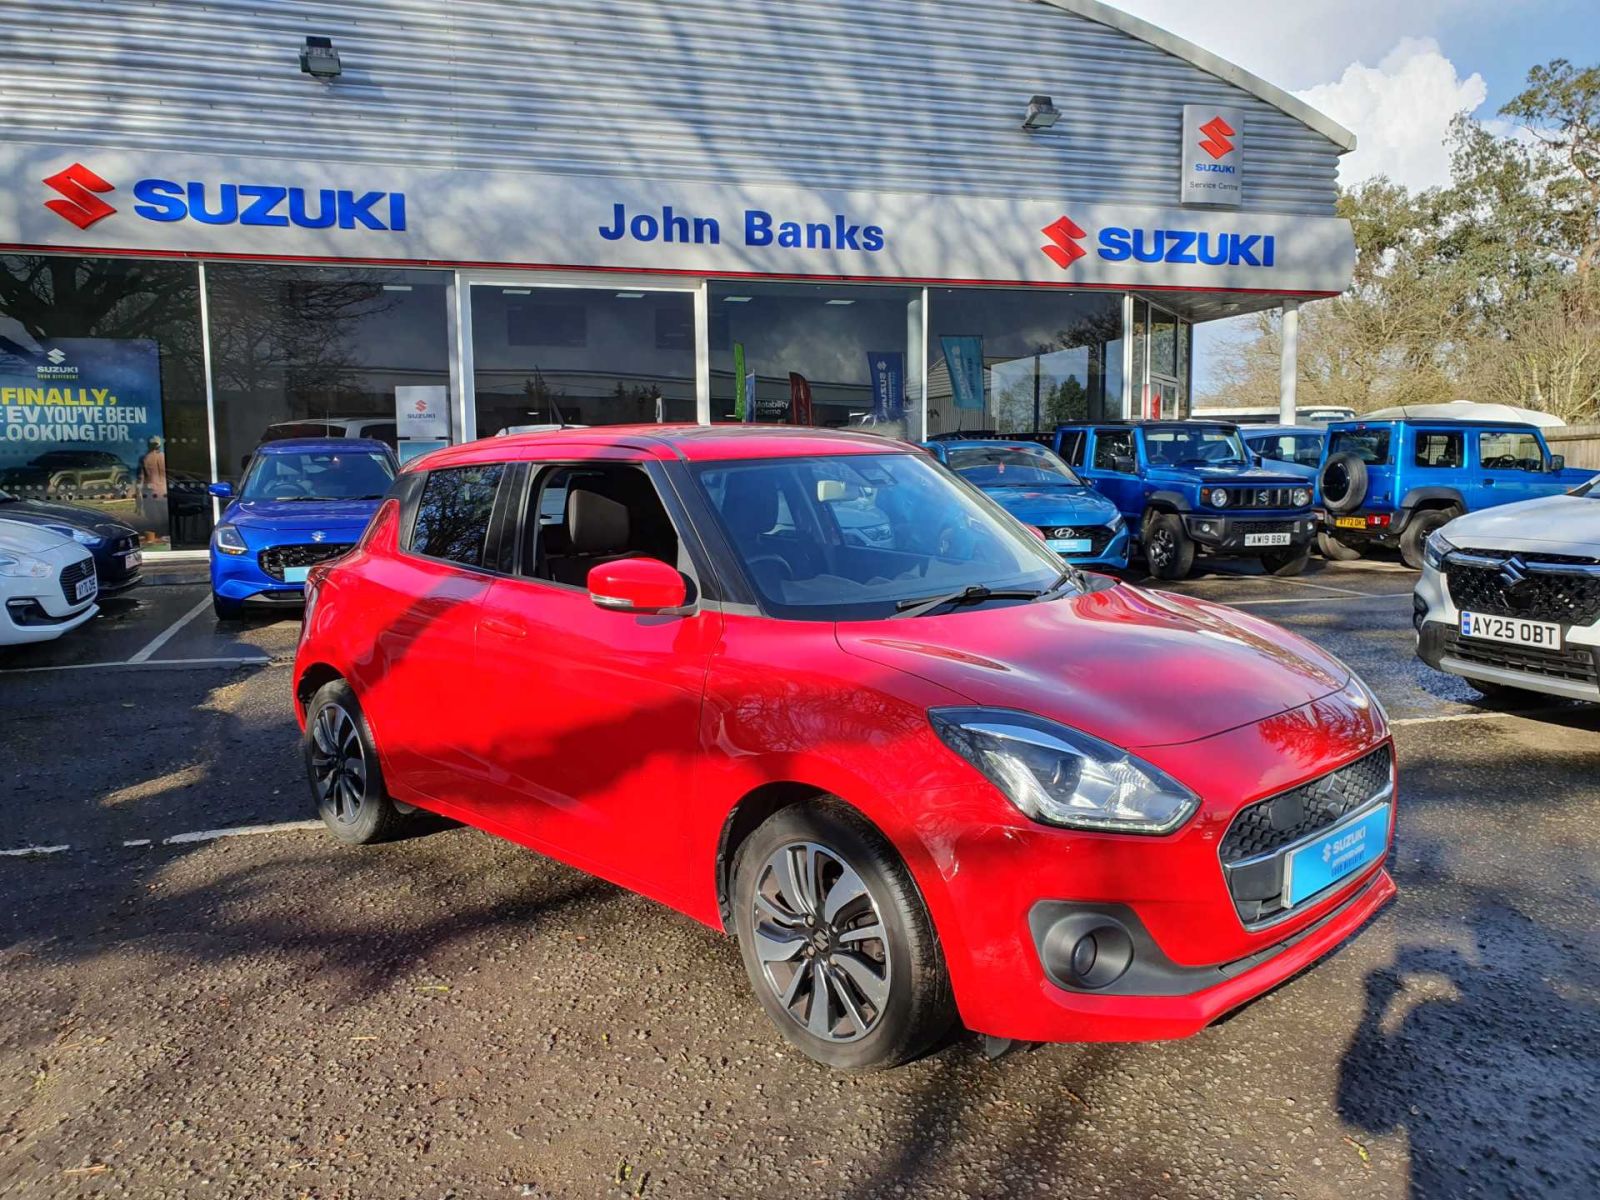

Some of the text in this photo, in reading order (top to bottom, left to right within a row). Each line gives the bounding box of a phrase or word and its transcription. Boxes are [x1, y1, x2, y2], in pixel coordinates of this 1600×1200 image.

[1195, 163, 1236, 174] SUZUKI
[1189, 181, 1239, 191] Service Centre
[133, 179, 406, 231] SUZUKI
[599, 203, 885, 251] John Banks
[1097, 227, 1275, 267] SUZUKI
[1, 387, 117, 405] FINALLY,
[7, 406, 40, 423] EV
[43, 406, 104, 423] YOU'VE
[106, 407, 147, 424] BEEN
[98, 425, 129, 441] FOR
[1252, 535, 1269, 544] AW19
[1473, 616, 1556, 645] AY25 OBT
[1333, 825, 1366, 854] SUZUKI
